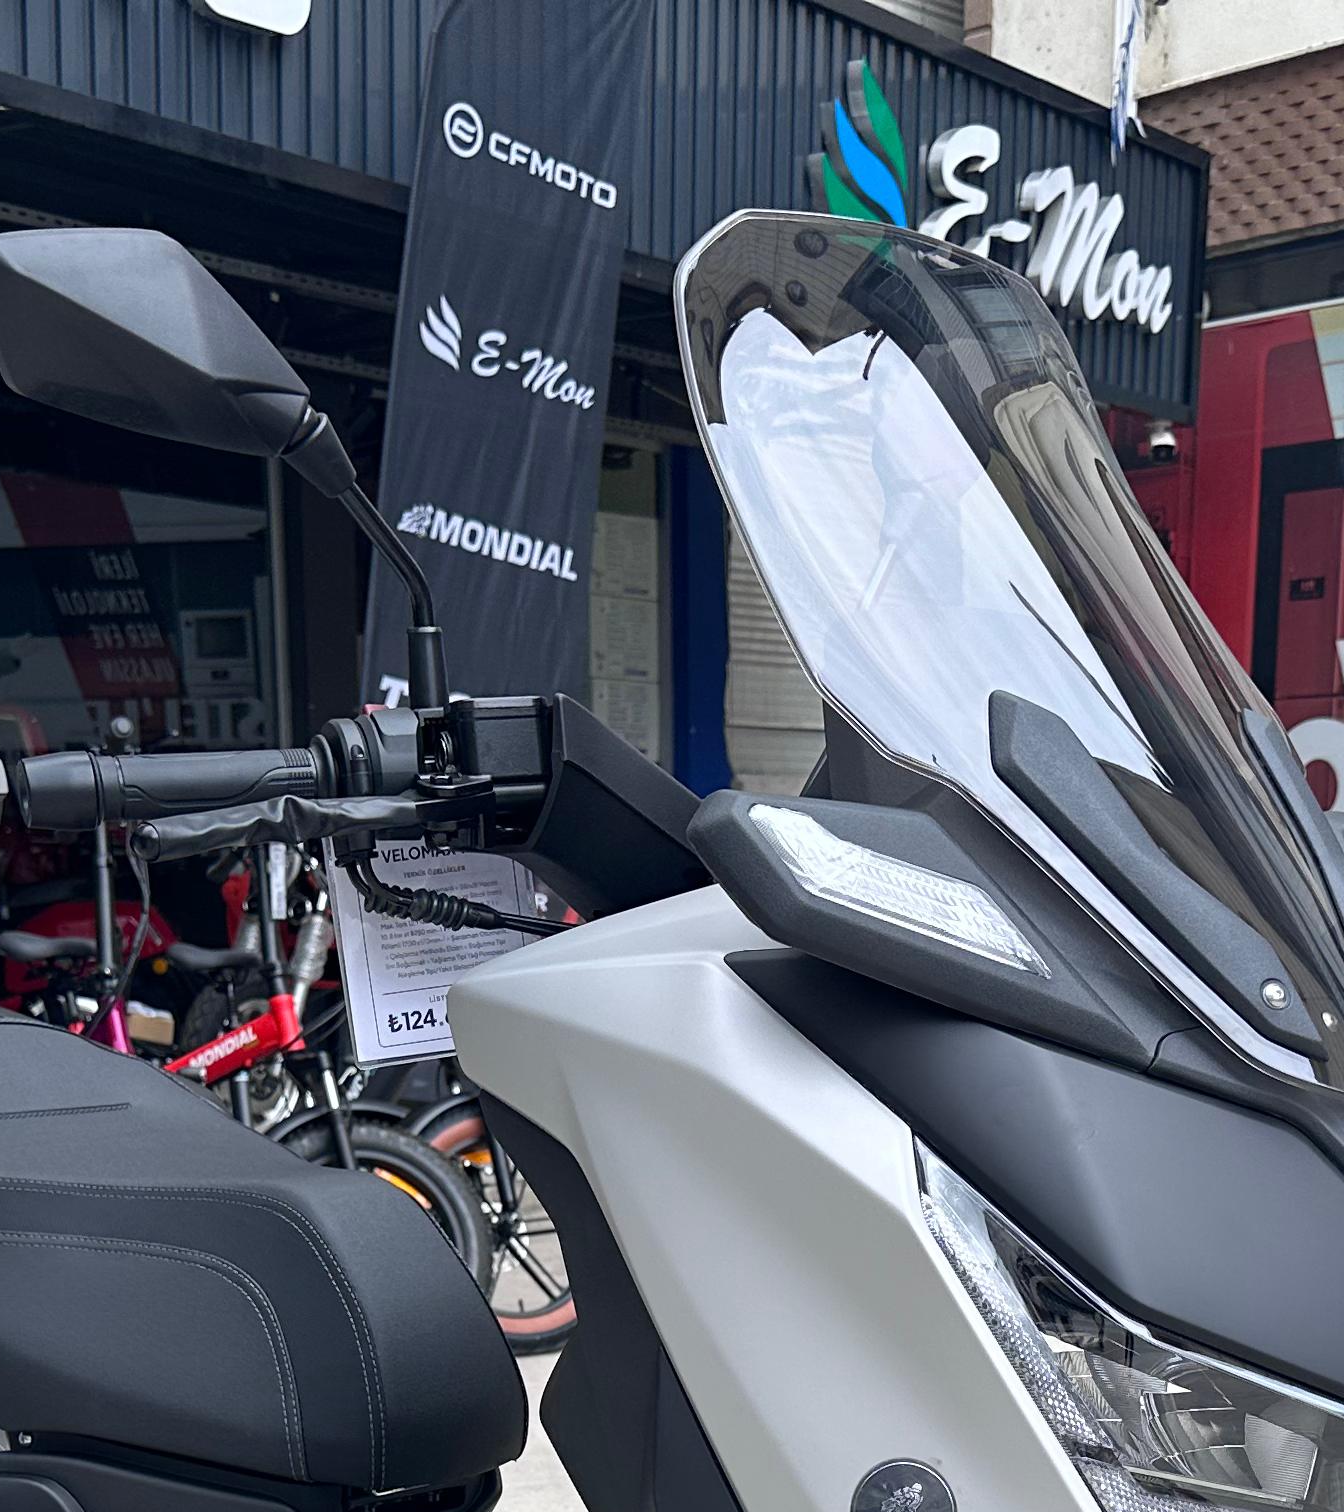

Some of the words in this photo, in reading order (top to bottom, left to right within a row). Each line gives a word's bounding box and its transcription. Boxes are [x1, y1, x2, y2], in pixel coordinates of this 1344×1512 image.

[488, 131, 617, 209] CFMOTO
[918, 124, 1173, 333] E-Mon
[470, 329, 595, 409] E-Mon
[429, 508, 578, 582] MONDIAL
[188, 1026, 258, 1067] MONDIAL
[387, 1007, 449, 1033] ₺124.
